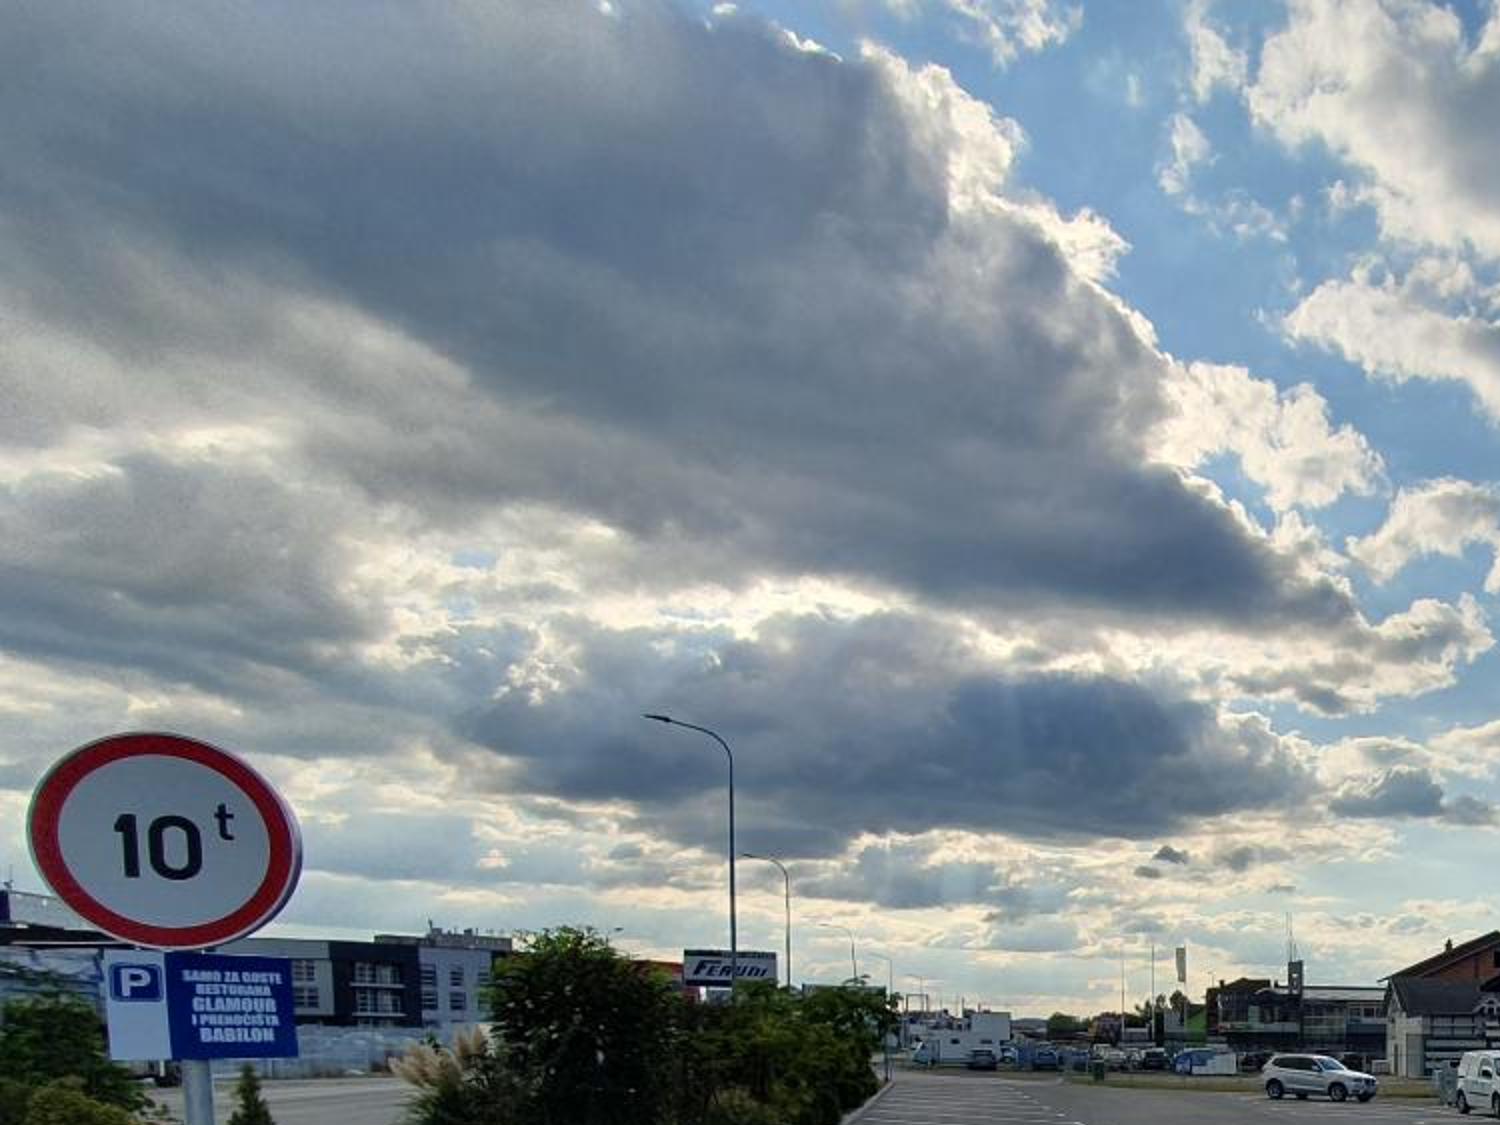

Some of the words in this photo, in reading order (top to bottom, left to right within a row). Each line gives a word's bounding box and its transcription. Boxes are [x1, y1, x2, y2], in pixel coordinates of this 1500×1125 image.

[114, 814, 203, 880] 10
[120, 968, 151, 997] P
[192, 997, 277, 1013] GLAMOUR
[199, 1027, 275, 1043] BABILON
